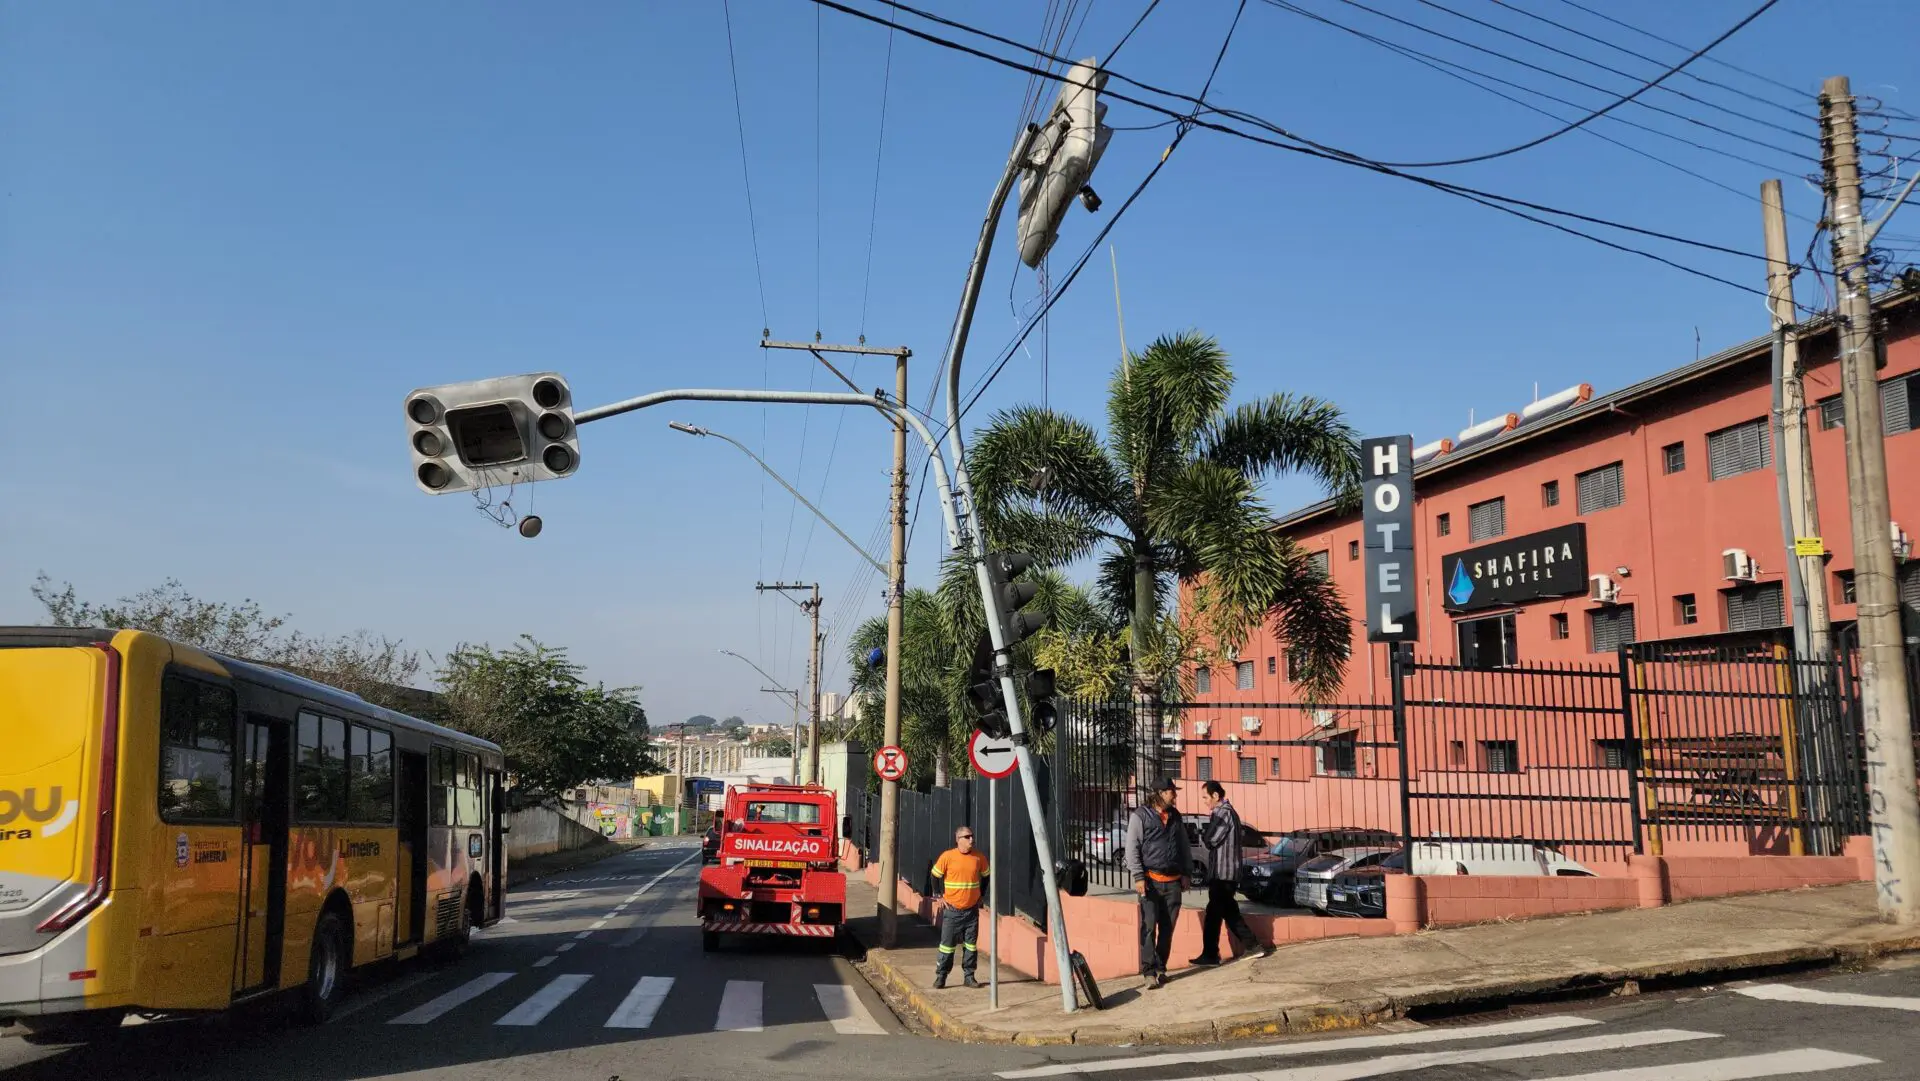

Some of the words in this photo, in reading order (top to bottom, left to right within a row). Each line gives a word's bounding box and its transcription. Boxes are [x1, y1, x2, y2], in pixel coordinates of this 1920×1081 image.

[1373, 444, 1404, 634] HOTEL
[1475, 542, 1573, 579] SHAFIRA
[1493, 567, 1552, 589] HOTEL
[734, 838, 819, 855] SINALIZAÇÃO
